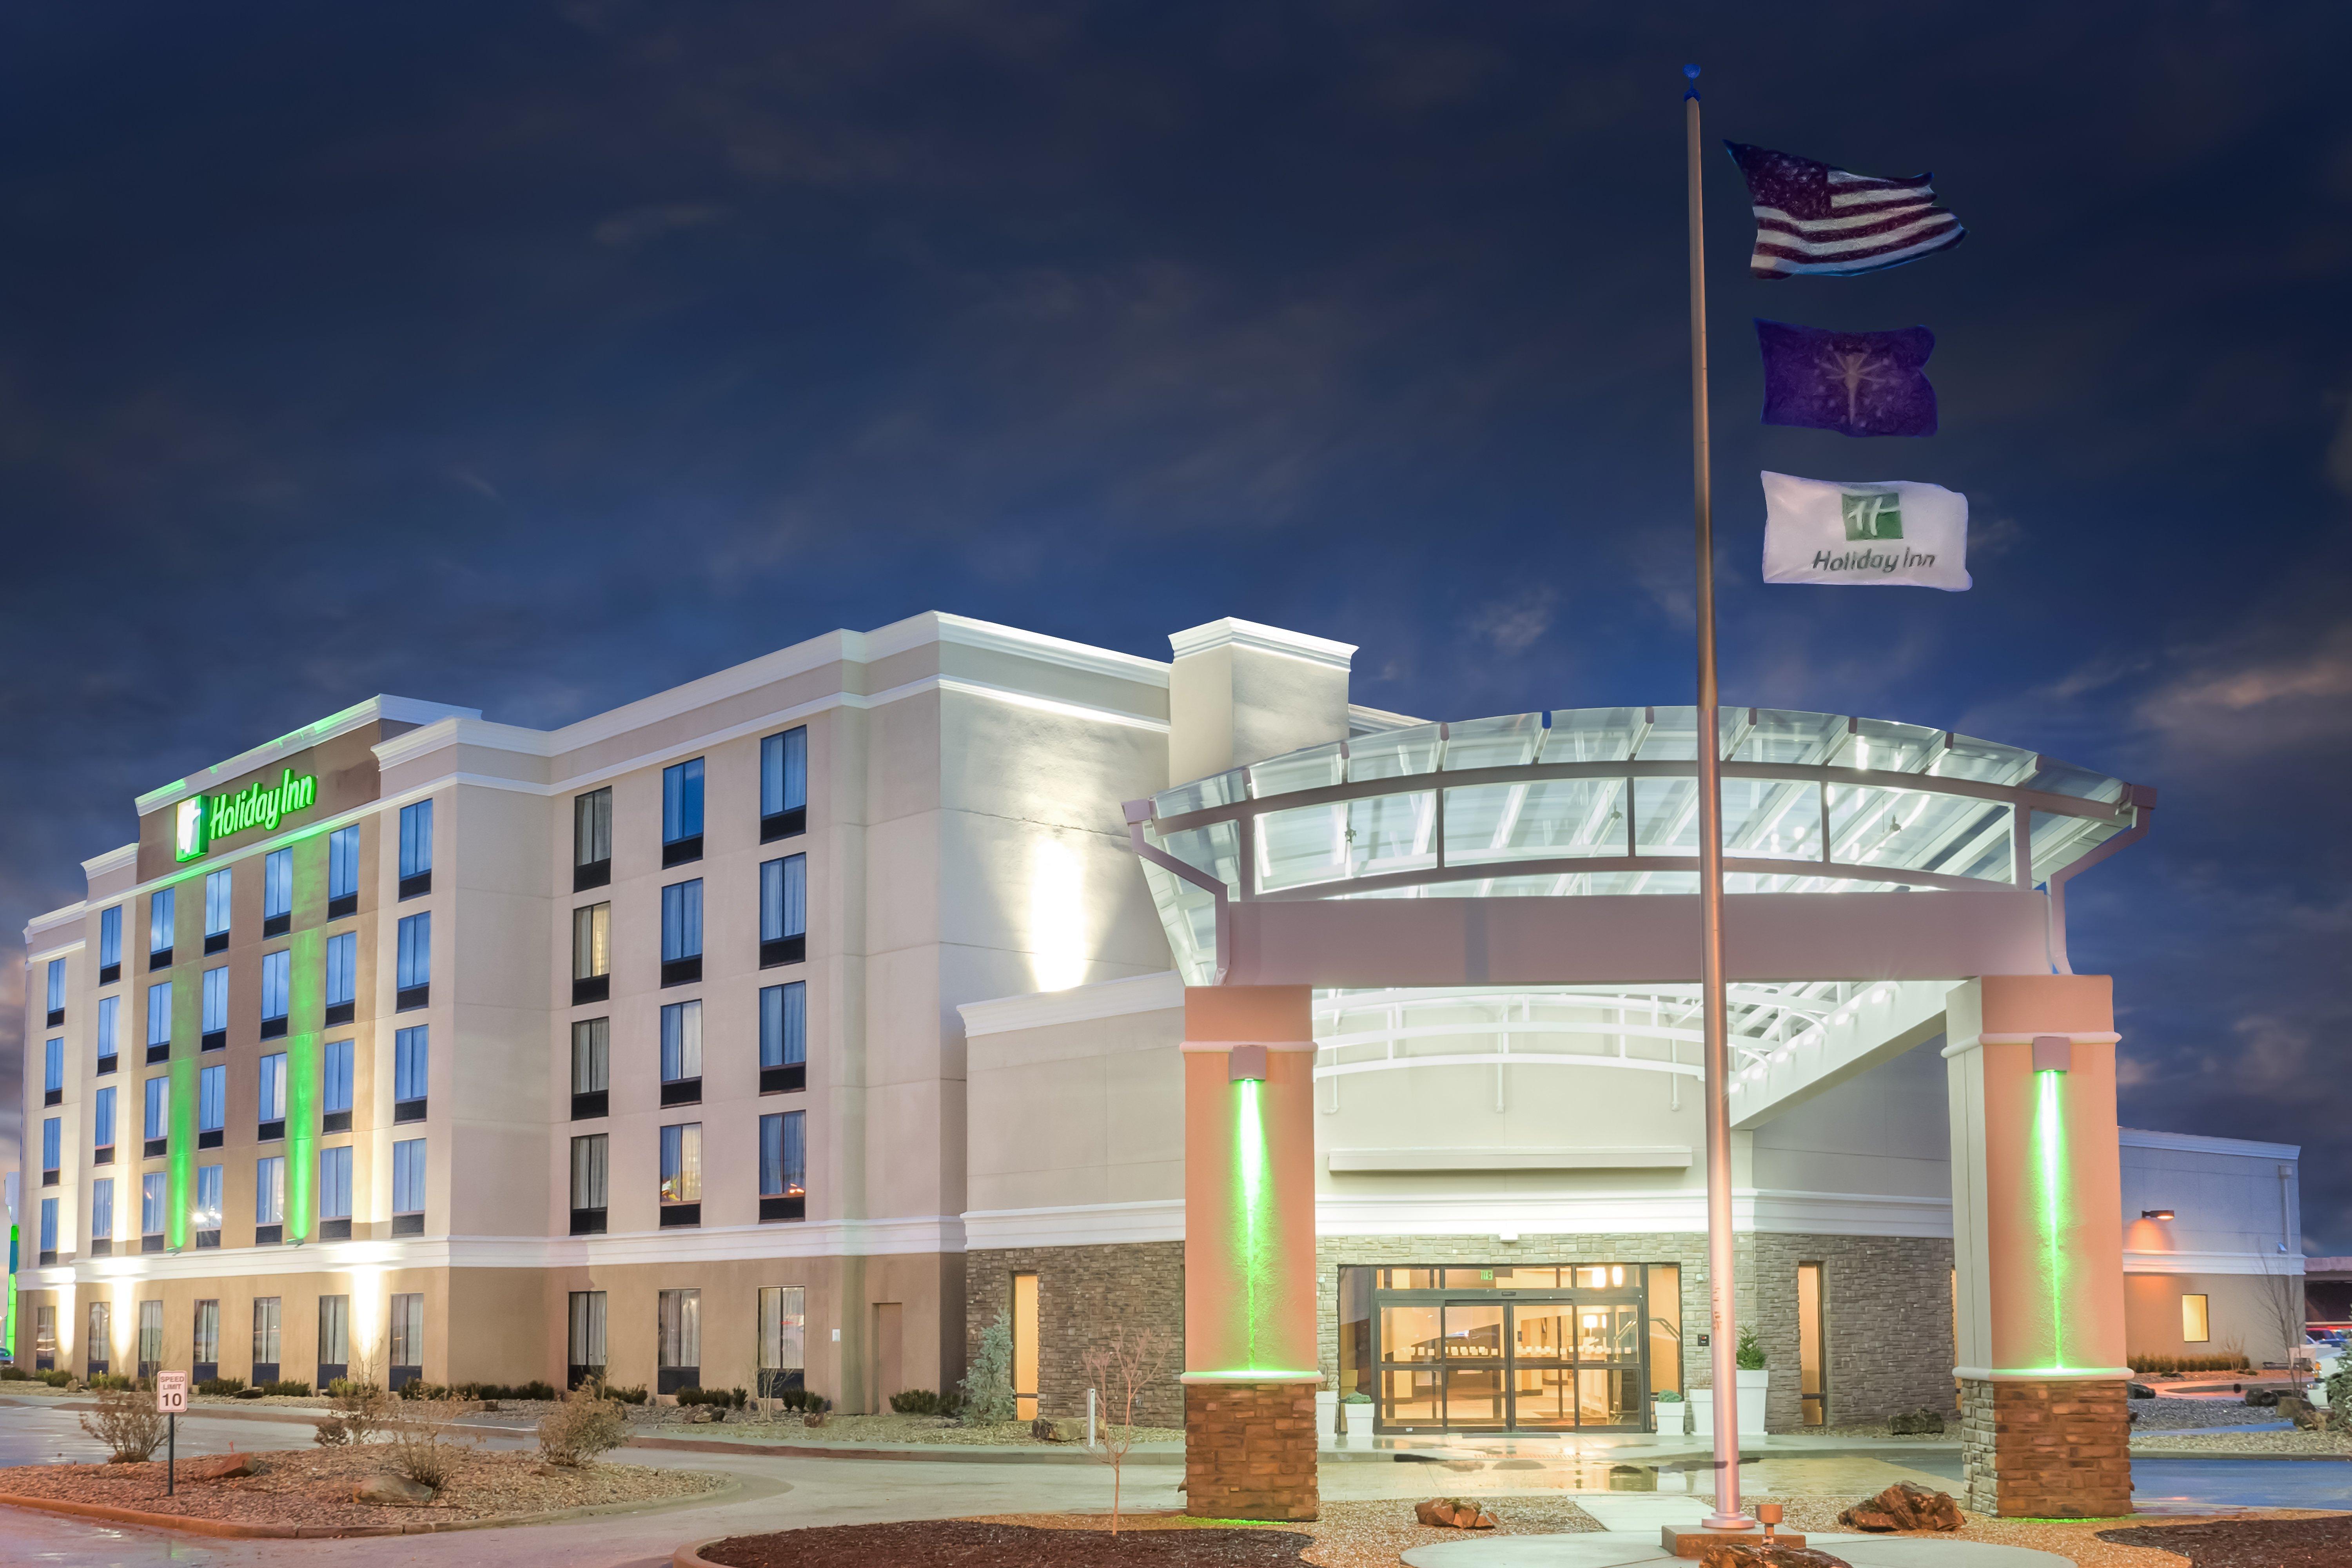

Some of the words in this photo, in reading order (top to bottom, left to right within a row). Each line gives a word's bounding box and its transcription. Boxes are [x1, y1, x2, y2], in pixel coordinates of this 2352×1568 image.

[1813, 548, 1900, 573] Holiday
[1903, 546, 1935, 567] Inn
[210, 782, 280, 840] Holiday
[281, 768, 314, 814] Inn
[163, 1393, 181, 1406] 10
